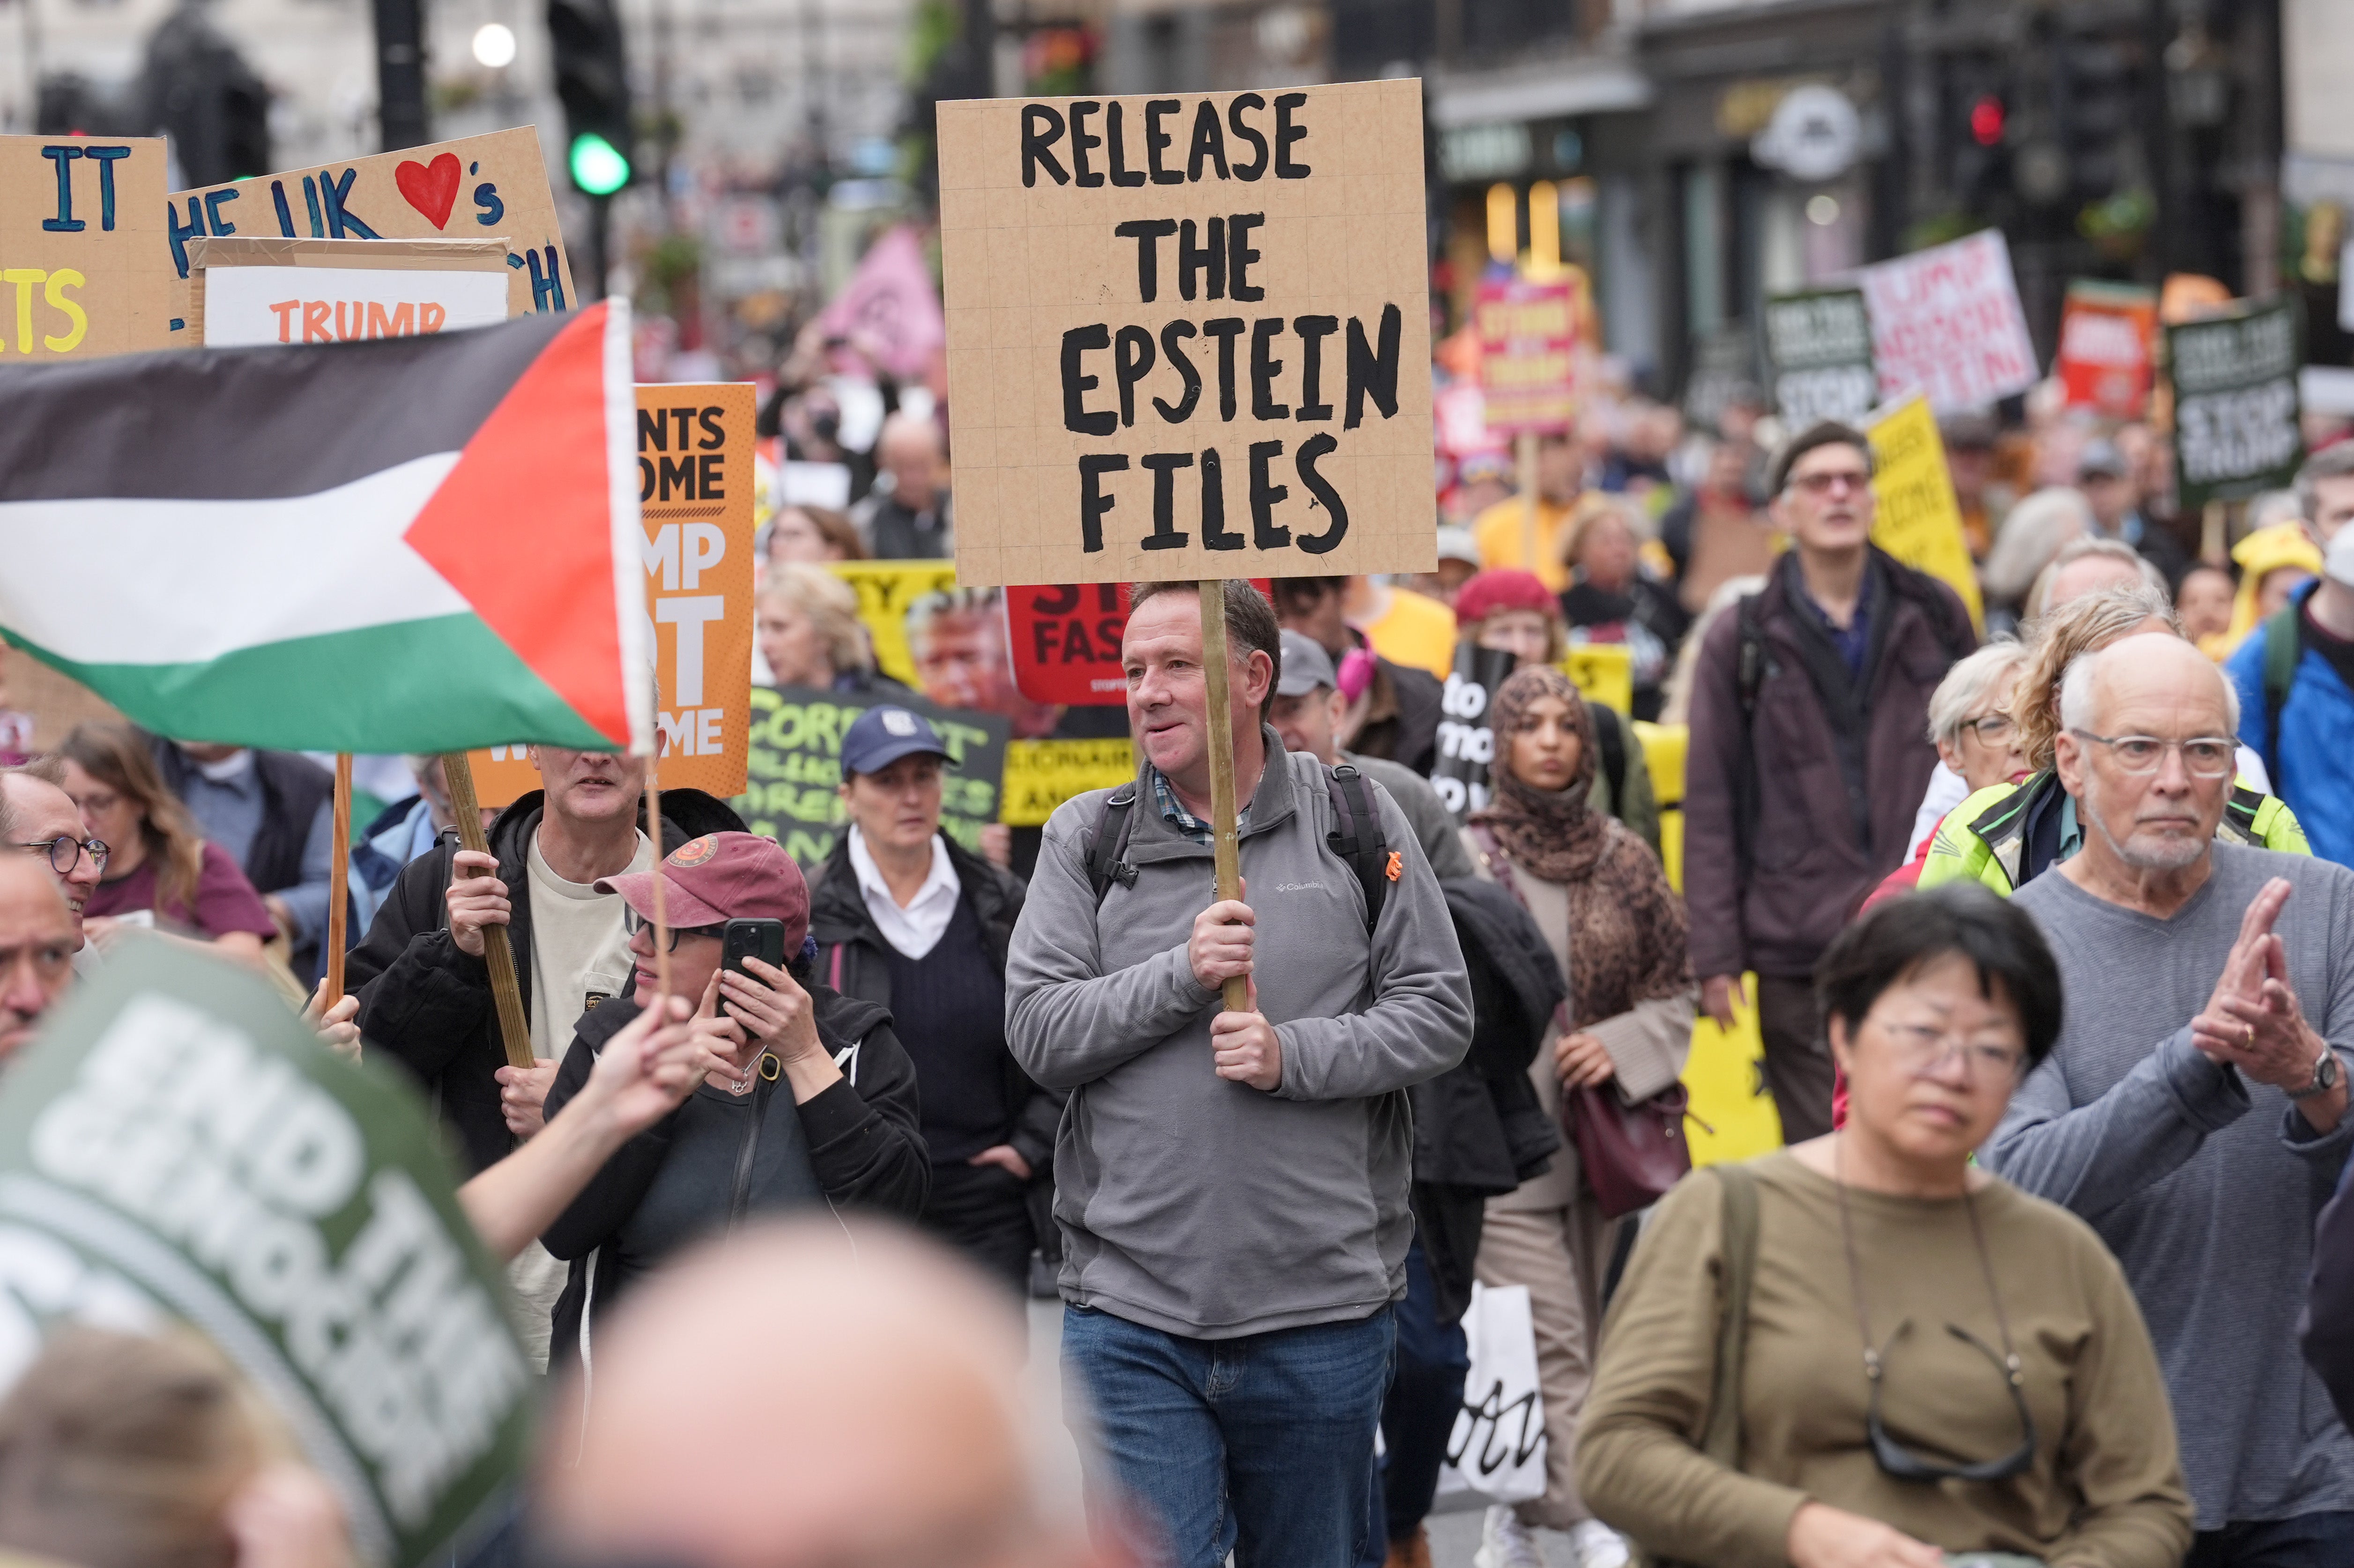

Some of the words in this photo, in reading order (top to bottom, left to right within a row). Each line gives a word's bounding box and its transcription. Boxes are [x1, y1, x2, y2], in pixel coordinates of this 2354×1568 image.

[1021, 92, 1312, 188] RELEASE
[41, 144, 132, 232] IT
[1114, 211, 1265, 303] THE
[0, 268, 88, 354] TS
[268, 299, 446, 345] TRUMP
[1060, 302, 1401, 436] EPSTEIN
[638, 406, 726, 451] NTS
[1078, 433, 1349, 555] FILES
[641, 522, 726, 592] MP
[1034, 618, 1123, 665] FAS
[659, 708, 724, 758] ME
[1286, 880, 1324, 891] Columbia
